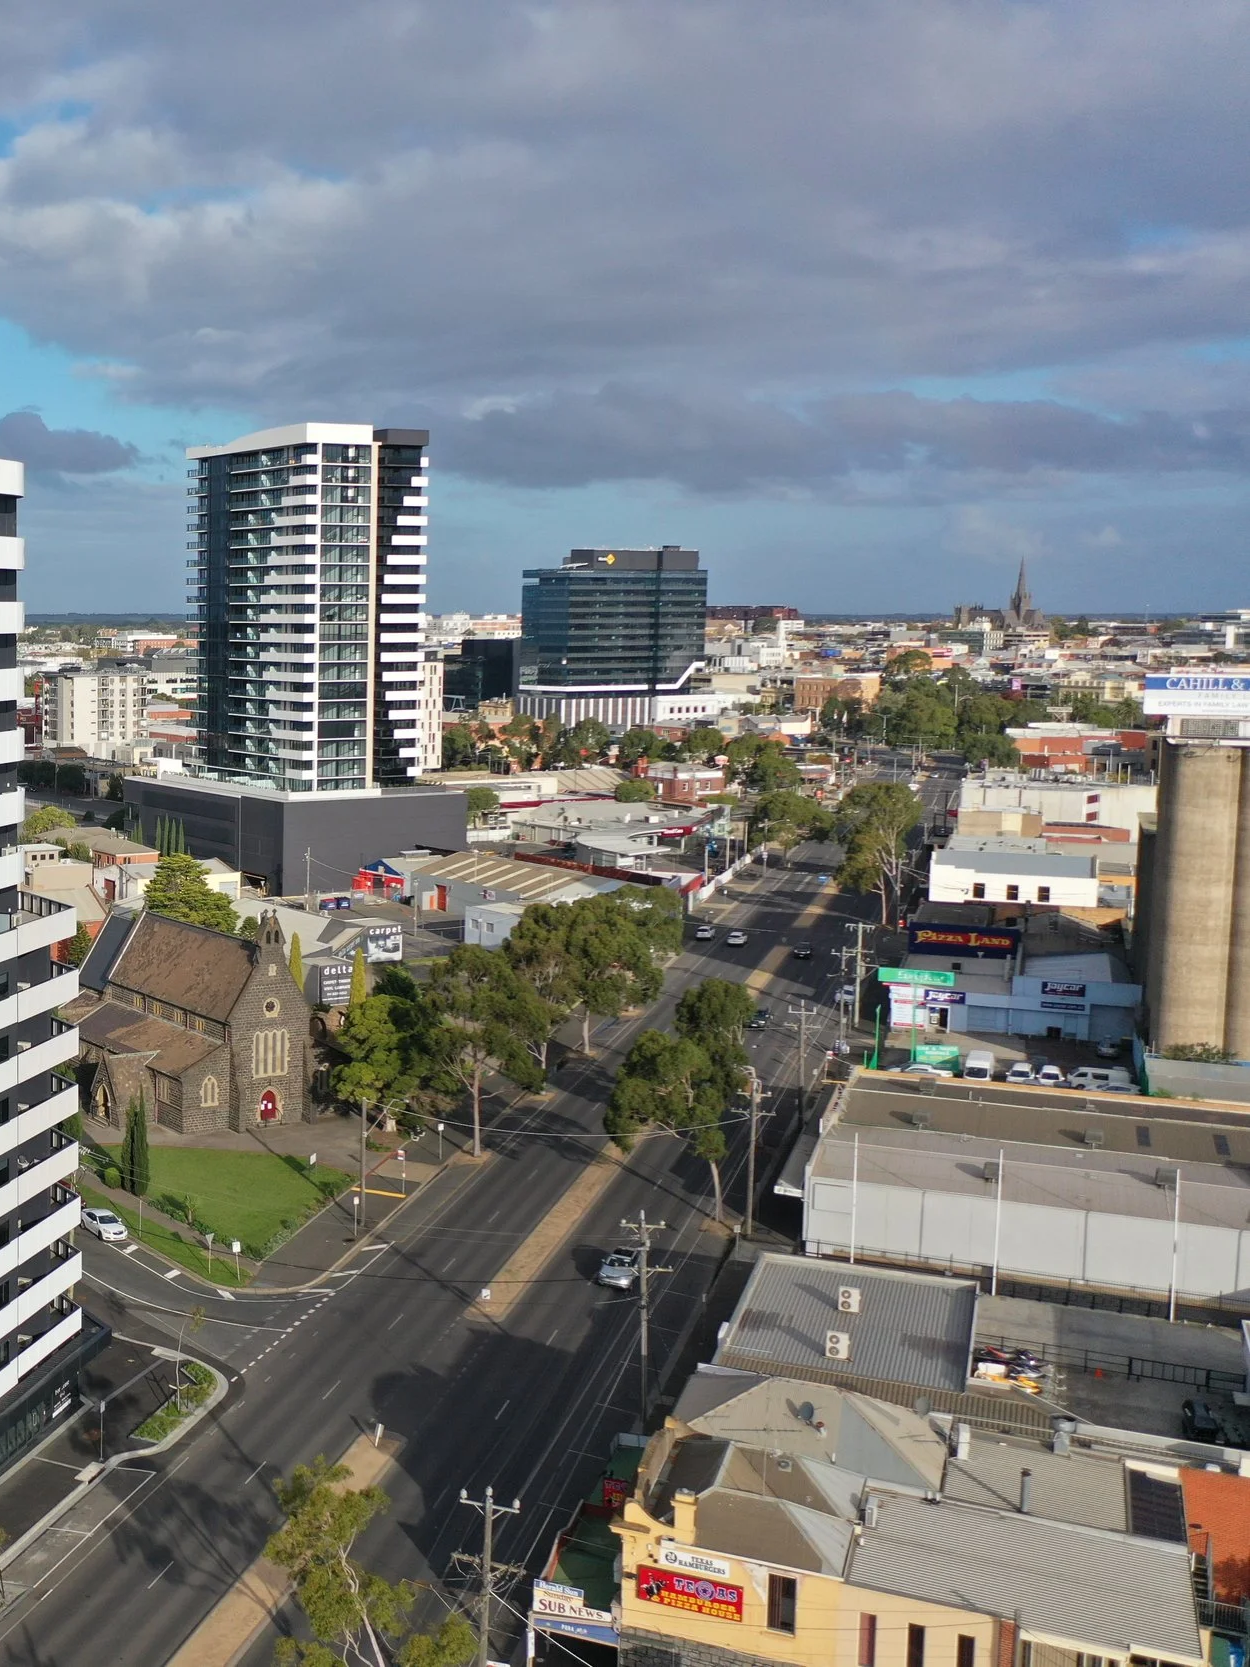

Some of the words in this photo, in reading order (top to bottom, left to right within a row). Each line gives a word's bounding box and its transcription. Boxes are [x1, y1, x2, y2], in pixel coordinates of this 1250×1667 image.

[1166, 678, 1227, 690] CAHILL
[1231, 679, 1245, 690] &
[369, 925, 402, 935] carpet
[914, 930, 963, 943] PIZZA
[968, 933, 1010, 947] LAND
[324, 965, 353, 975] delta
[678, 1559, 726, 1575] HAMBURGERS
[691, 1556, 714, 1566] TEXAS
[539, 1581, 563, 1593] Herald
[564, 1587, 579, 1597] Sun
[673, 1577, 738, 1603] TEAS
[538, 1598, 566, 1614] SUB
[660, 1590, 737, 1613] HAMBURGER
[663, 1597, 699, 1612] PIZZA
[701, 1606, 741, 1621] HOUSE
